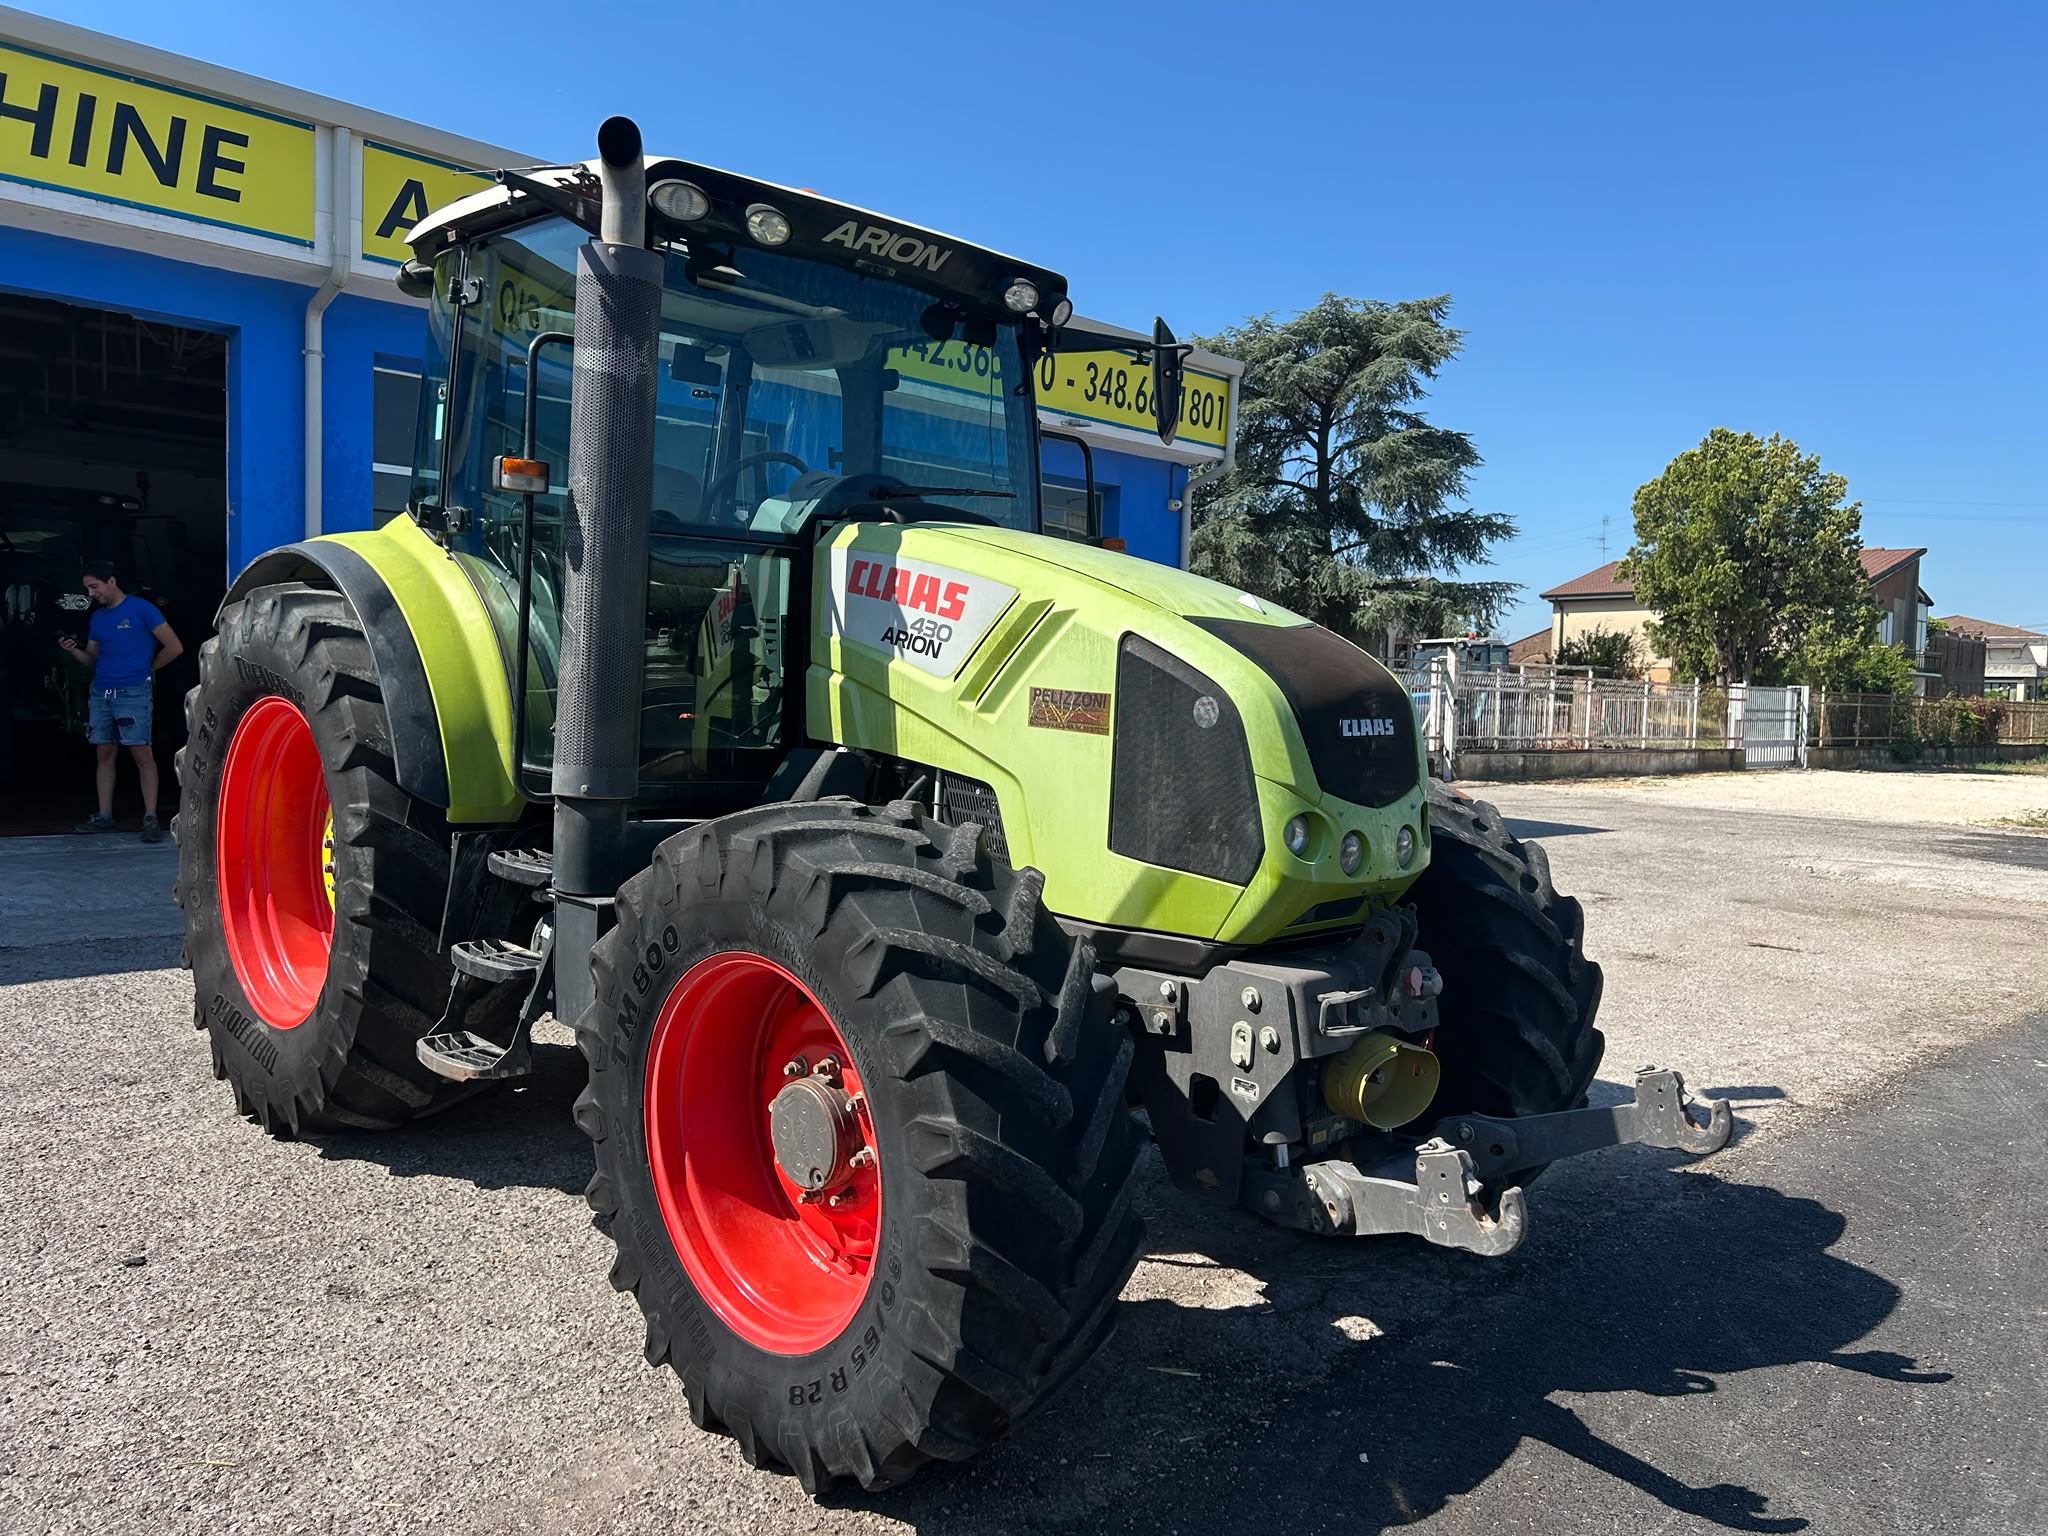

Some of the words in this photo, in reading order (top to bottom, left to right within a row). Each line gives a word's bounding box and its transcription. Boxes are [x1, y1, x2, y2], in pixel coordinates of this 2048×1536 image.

[0, 72, 249, 203] HINE
[821, 220, 953, 272] ARION
[847, 559, 970, 621] CLAAS
[881, 626, 942, 660] ARION
[910, 617, 953, 643] 430
[1341, 718, 1395, 737] CLAAS
[611, 990, 640, 1068] TM
[632, 922, 681, 997] 800
[630, 1207, 717, 1372] TRELLEBORG
[788, 1379, 823, 1408] 28
[830, 1366, 849, 1395] R
